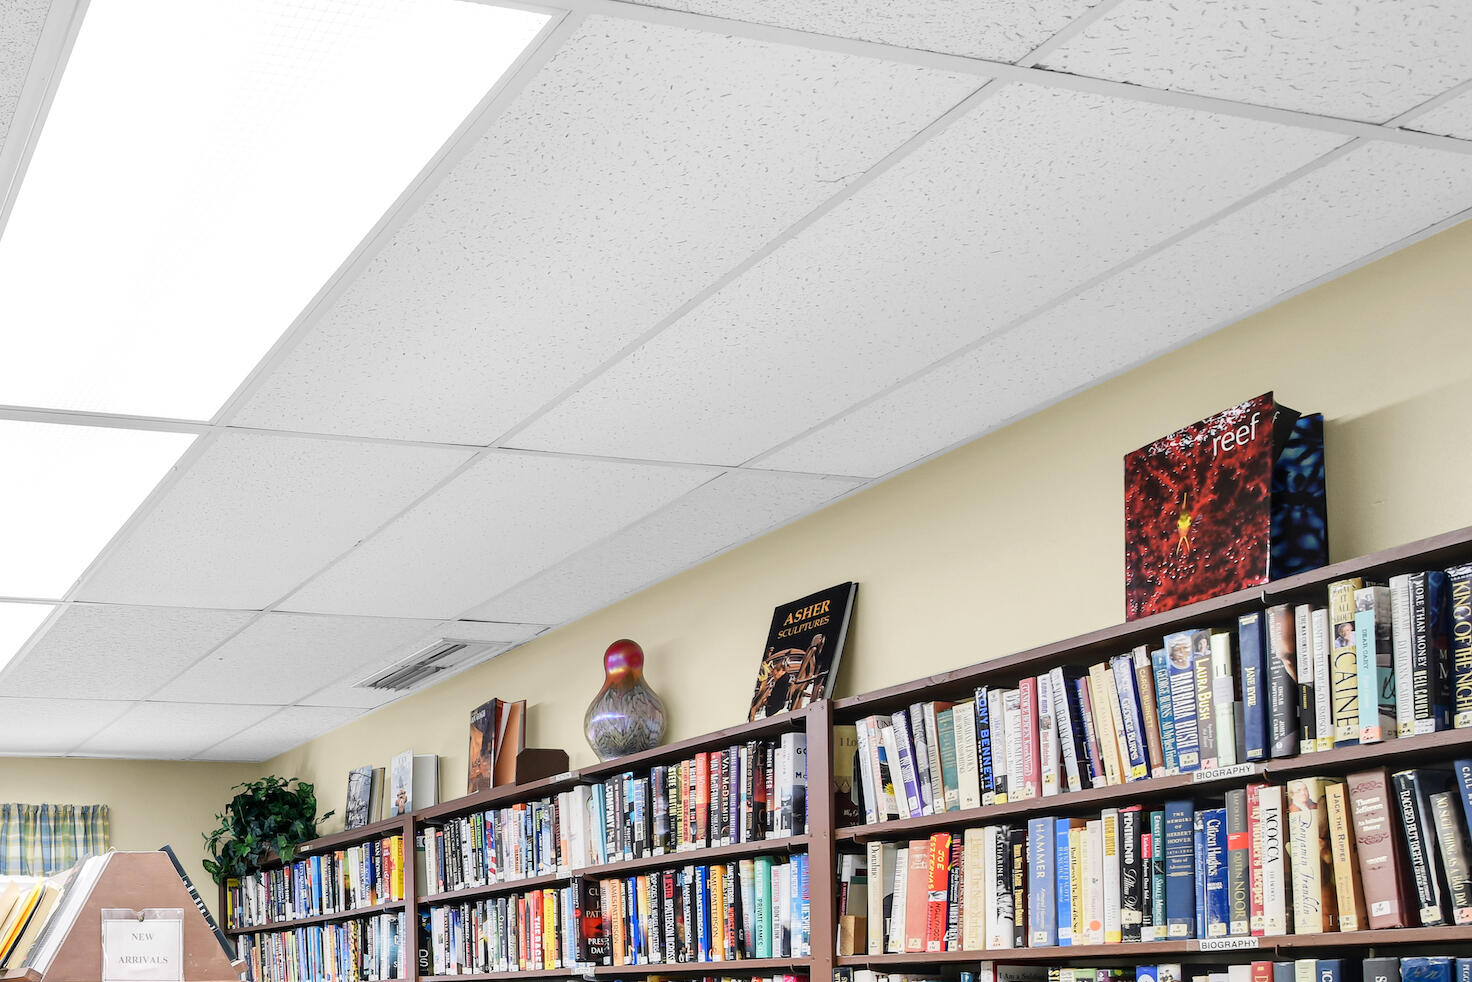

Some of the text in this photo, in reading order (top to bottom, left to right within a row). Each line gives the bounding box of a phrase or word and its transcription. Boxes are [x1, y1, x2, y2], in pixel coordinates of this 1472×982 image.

[1211, 412, 1260, 456] reef
[778, 616, 830, 639] SCULPTURES
[784, 600, 830, 626] ASHER
[1415, 582, 1427, 667] MORE THAN MONEY
[1138, 669, 1153, 728] CAROL BURNETT
[1196, 658, 1210, 720] LAURA BUSH
[1334, 651, 1359, 726] CAINE
[1414, 670, 1429, 718] NEIL CAVUTO
[1171, 672, 1199, 748] BARBARA BUSH
[978, 691, 993, 790] TONY BENNETT
[1196, 766, 1252, 781] BIOGRAPHY
[605, 787, 615, 829] COMPANY
[1333, 794, 1342, 813] JACK
[1436, 796, 1448, 809] NO
[1439, 810, 1451, 831] SUCH
[1122, 812, 1134, 864] PENTIMENTO
[1206, 819, 1222, 876] Citizen Hughes
[1265, 808, 1281, 863] IACOCCA
[1337, 833, 1346, 862] RIPPER
[1400, 791, 1424, 866] RAGGED BUT RIGHT
[1442, 832, 1455, 855] THING
[870, 844, 880, 878] Donahue
[1035, 823, 1046, 878] HAMMER
[1297, 816, 1319, 915] Benjamin Franklin
[1447, 858, 1458, 867] AS
[1233, 851, 1247, 918] QUEEN NOOR
[1451, 875, 1466, 890] BAD
[1453, 892, 1467, 907] DAY
[131, 932, 154, 941] NEW
[1201, 938, 1257, 950] BIOGRAPHY
[119, 955, 168, 965] ARRIVALS
